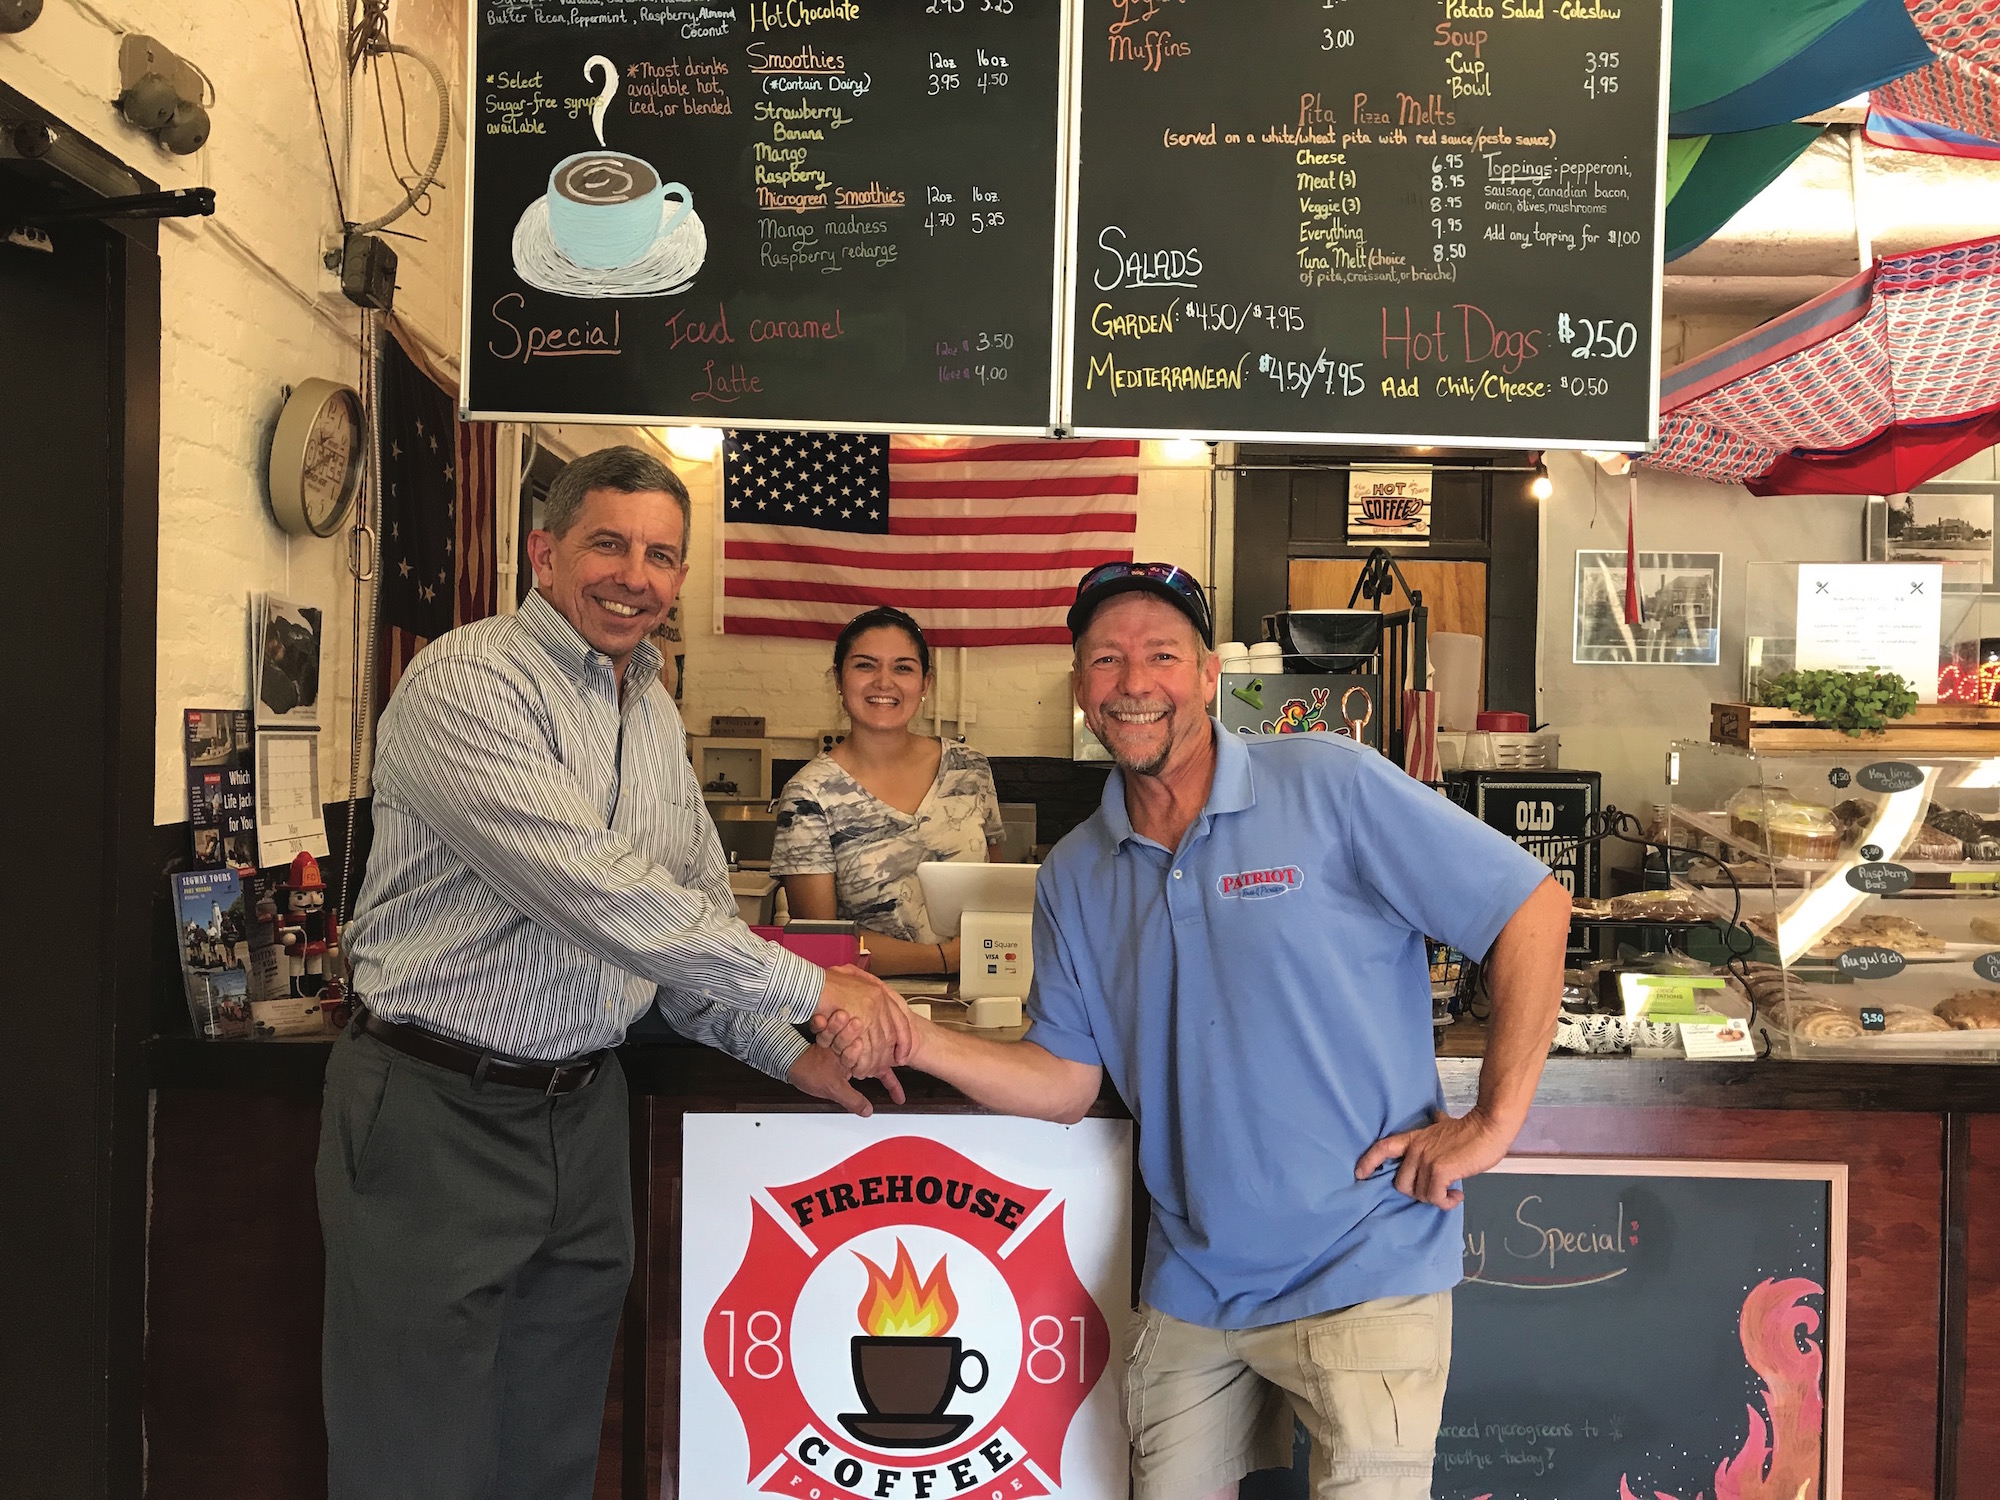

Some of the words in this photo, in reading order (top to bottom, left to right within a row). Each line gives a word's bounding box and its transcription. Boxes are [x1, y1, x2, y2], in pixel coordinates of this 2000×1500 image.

[487, 9, 527, 26] Butter
[750, 1, 787, 32] Hot
[787, 0, 860, 27] Chocolate
[1501, 0, 1544, 19] Salad
[681, 20, 729, 39] Coconut
[1433, 22, 1488, 58] Soup
[746, 42, 846, 71] Smoothies
[929, 52, 957, 69] 12oz
[1108, 31, 1191, 72] Muffins
[1321, 28, 1354, 51] 3.00
[1585, 52, 1620, 73] 3.95
[685, 57, 729, 76] drinks
[627, 80, 688, 97] available
[697, 77, 724, 95] hot,
[829, 72, 872, 97] Dairy)
[927, 74, 960, 95] 3.95
[977, 72, 1008, 94] 4.50
[1584, 75, 1619, 100] 4.95
[486, 91, 557, 123] Sugar-free
[564, 96, 604, 119] syrups
[664, 104, 679, 115] or
[684, 98, 732, 115] blended
[754, 97, 853, 129] Strawberry
[1298, 92, 1336, 126] Pita
[1354, 92, 1390, 125] Pizza
[1397, 92, 1456, 126] Melts
[487, 118, 546, 134] available
[773, 121, 824, 141] Banana
[1164, 122, 1217, 148] (served
[1225, 133, 1240, 144] on
[1246, 133, 1256, 143] a
[1262, 124, 1336, 146] white/wheat
[1342, 127, 1372, 149] pita
[1378, 128, 1407, 145] with
[1416, 129, 1437, 145] red
[1440, 126, 1512, 153] sauce/pesto
[1516, 128, 1557, 149] sauce)
[753, 142, 807, 168] Mango
[1296, 149, 1347, 165] Cheese
[1431, 154, 1464, 173] 6.95
[755, 165, 832, 190] Raspberry
[1297, 170, 1336, 191] Meat
[1339, 170, 1357, 190] (3)
[1431, 174, 1465, 192] 8.95
[1482, 151, 1557, 186] Toppings:
[1560, 155, 1633, 184] pepperoni,
[756, 187, 828, 213] Microgreen
[834, 181, 906, 207] Smoothies
[1484, 185, 1535, 199] sausage,
[1537, 181, 1587, 198] canadian
[1594, 181, 1629, 200] bacon,
[1300, 197, 1340, 220] Veggie
[1342, 197, 1361, 215] (3)
[1430, 196, 1463, 213] 8.95
[1548, 199, 1607, 213] mushrooms
[758, 218, 818, 251] Mango
[825, 214, 887, 235] madness
[925, 212, 956, 236] 4.70
[971, 212, 1005, 234] 5.25
[1300, 216, 1367, 249] Everything
[1431, 217, 1463, 239] 9.95
[1483, 223, 1505, 240] Add
[1510, 230, 1533, 249] any
[1533, 221, 1576, 250] topping
[1579, 223, 1600, 251] for
[760, 243, 841, 274] Raspberry
[842, 243, 898, 267] recharge
[1296, 246, 1329, 269] Tuna
[1332, 247, 1366, 268] Melt
[1368, 247, 1406, 270] (choice
[1433, 243, 1466, 262] 8.50
[1300, 270, 1314, 287] of
[1317, 268, 1346, 287] pita,
[1347, 266, 1400, 284] croissant,
[1401, 272, 1410, 280] or
[1411, 262, 1456, 283] brioche)
[489, 293, 621, 364] Special
[665, 303, 734, 350] Iced
[750, 310, 845, 342] caramel
[1382, 306, 1448, 370] Hot
[691, 359, 764, 402] Latte
[1381, 376, 1419, 398] Add
[1373, 482, 1406, 495] HOT
[1365, 500, 1414, 520] COFFEE
[229, 771, 251, 786] Which
[1832, 772, 1849, 784] 4.50
[1868, 768, 1887, 785] Key
[1890, 767, 1912, 779] lime
[223, 794, 238, 810] Life
[228, 818, 240, 832] for
[1516, 801, 1554, 831] OLD
[182, 876, 207, 886] SEGWAY
[209, 872, 231, 883] TOURS
[1222, 868, 1296, 893] PATRIOT
[1858, 864, 1908, 882] Raspberry
[993, 940, 1018, 949] Square
[1842, 954, 1903, 972] Rugulach
[791, 1175, 1025, 1231] FIREHOUSE
[719, 1310, 783, 1379] 18
[1026, 1315, 1086, 1383] 81
[1486, 1423, 1573, 1446] microgreens
[1581, 1419, 1598, 1438] to
[799, 1436, 1013, 1499] COFFEE
[1435, 1449, 1493, 1472] moothie
